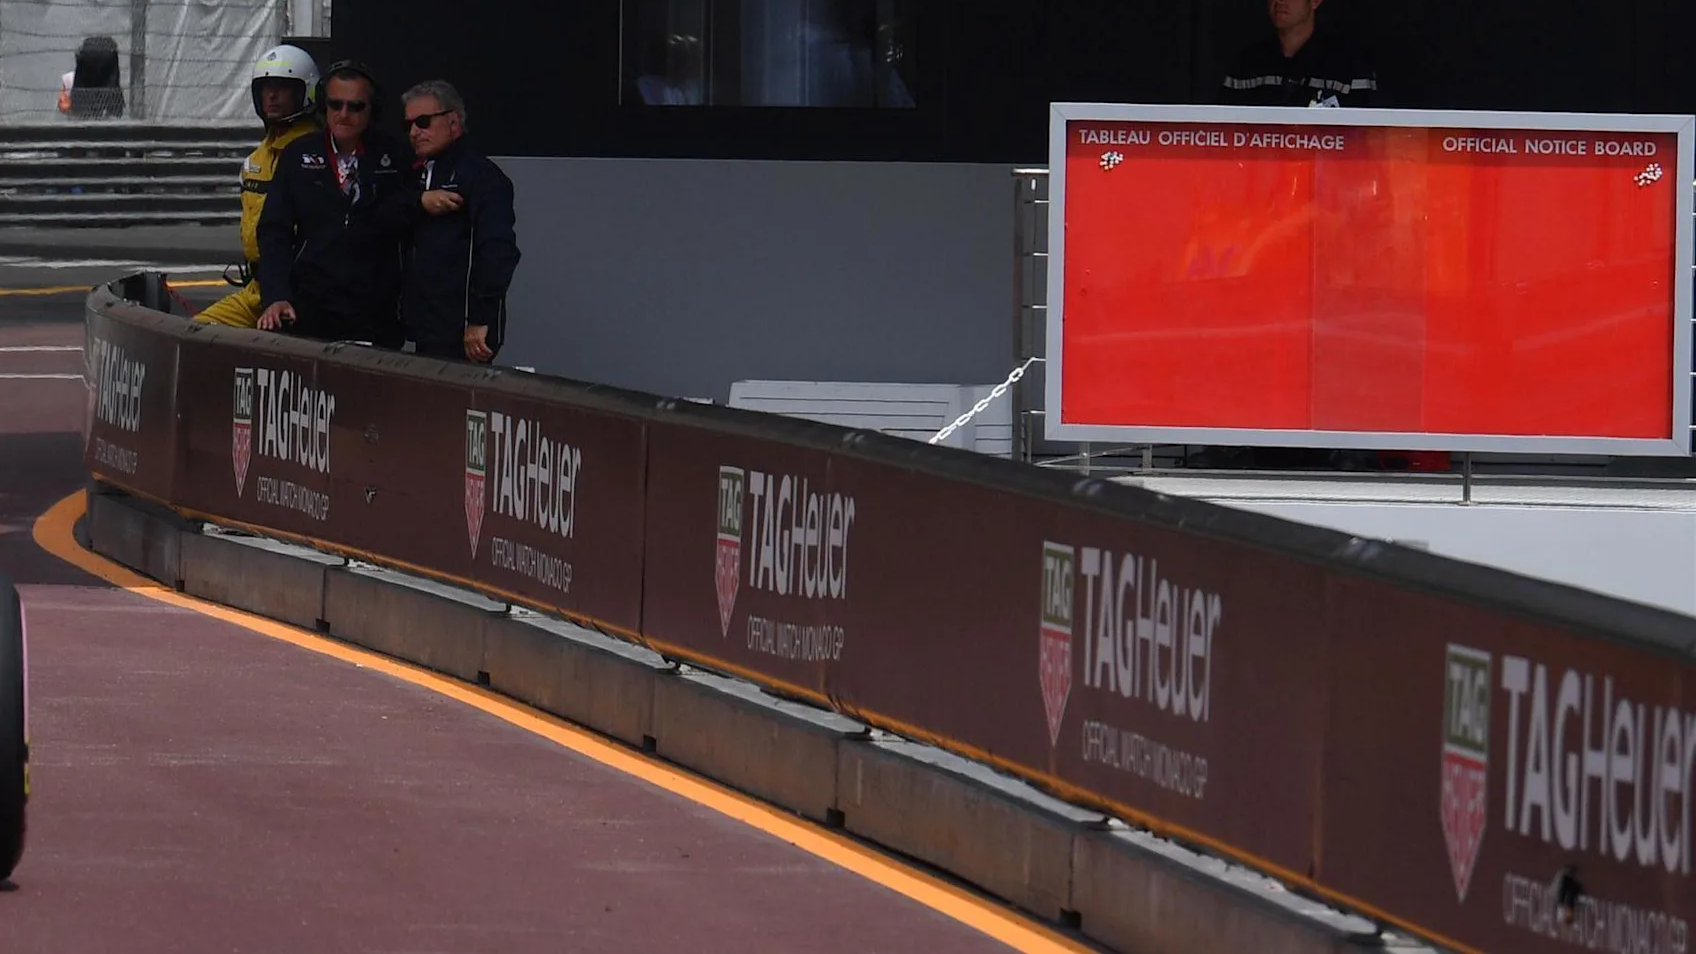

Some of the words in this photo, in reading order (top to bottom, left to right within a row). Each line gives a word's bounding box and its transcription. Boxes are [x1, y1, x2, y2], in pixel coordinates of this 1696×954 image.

[1079, 129, 1151, 145] TABLEAU
[1158, 130, 1228, 147] OFFICIEL
[1233, 131, 1345, 150] D'AFFICHAGE
[1442, 136, 1518, 154] OFFICIAL
[1525, 138, 1587, 155] NOTICE
[1595, 140, 1657, 156] BOARD
[256, 367, 336, 474] TAGHeuer
[468, 420, 485, 467] TAG
[490, 411, 582, 539] TAGHeuer
[721, 478, 742, 531] TAG
[749, 470, 855, 600] TAGHeuer
[1045, 556, 1070, 621] TAG
[1080, 546, 1222, 723] TAGHeuer
